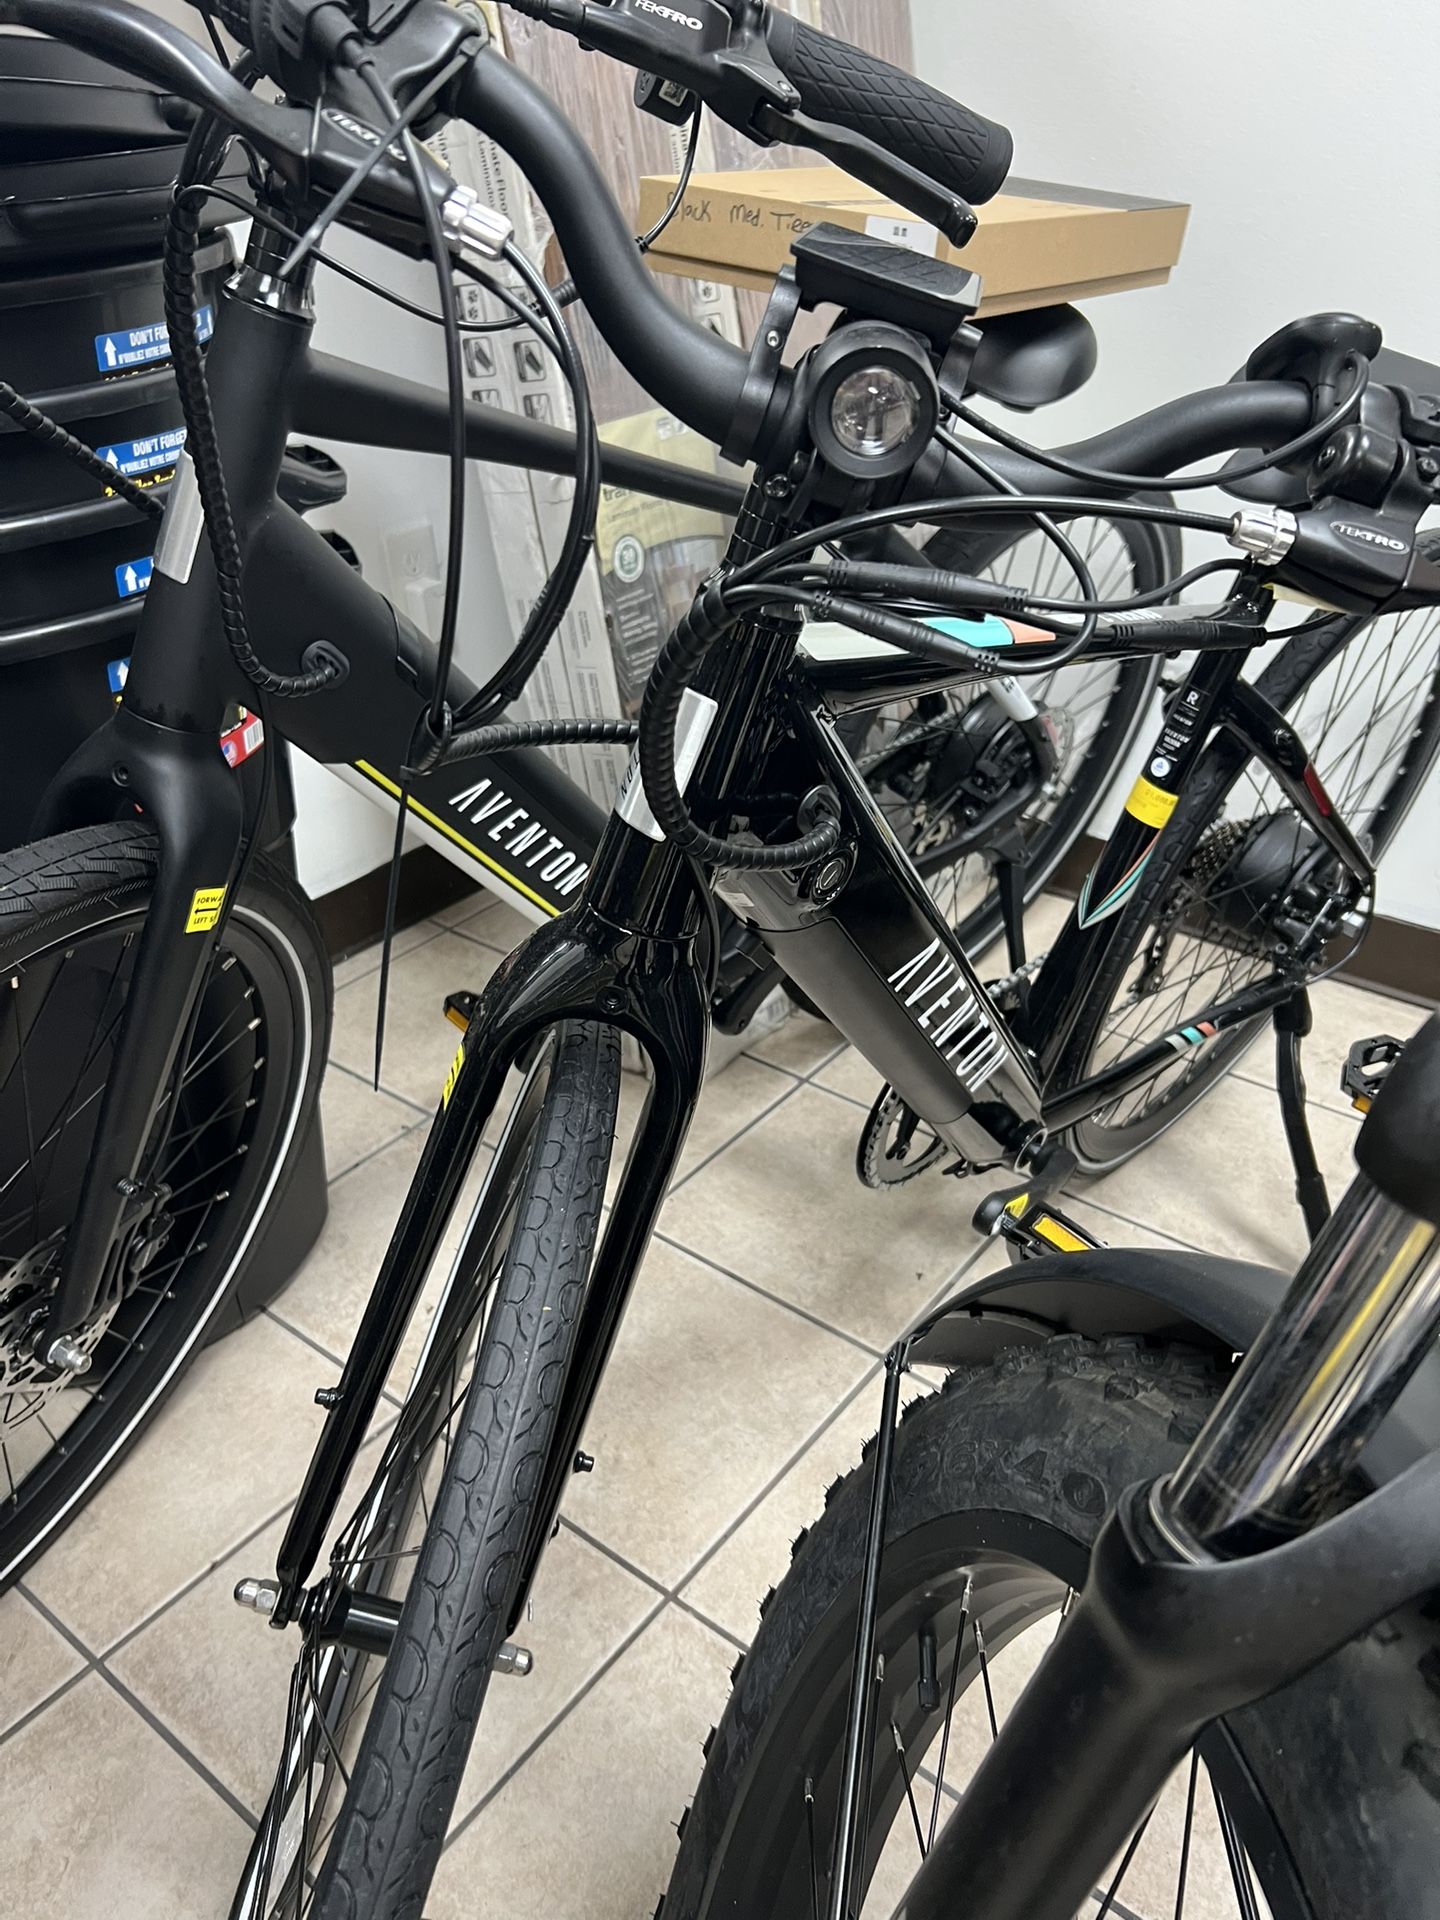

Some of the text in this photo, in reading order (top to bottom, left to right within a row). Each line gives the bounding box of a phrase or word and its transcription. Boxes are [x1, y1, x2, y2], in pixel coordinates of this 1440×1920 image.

[132, 439, 159, 456] DON'T
[1337, 524, 1405, 550] TEKTRO
[448, 777, 591, 897] AVENTON
[886, 936, 1010, 1094] AVENTON
